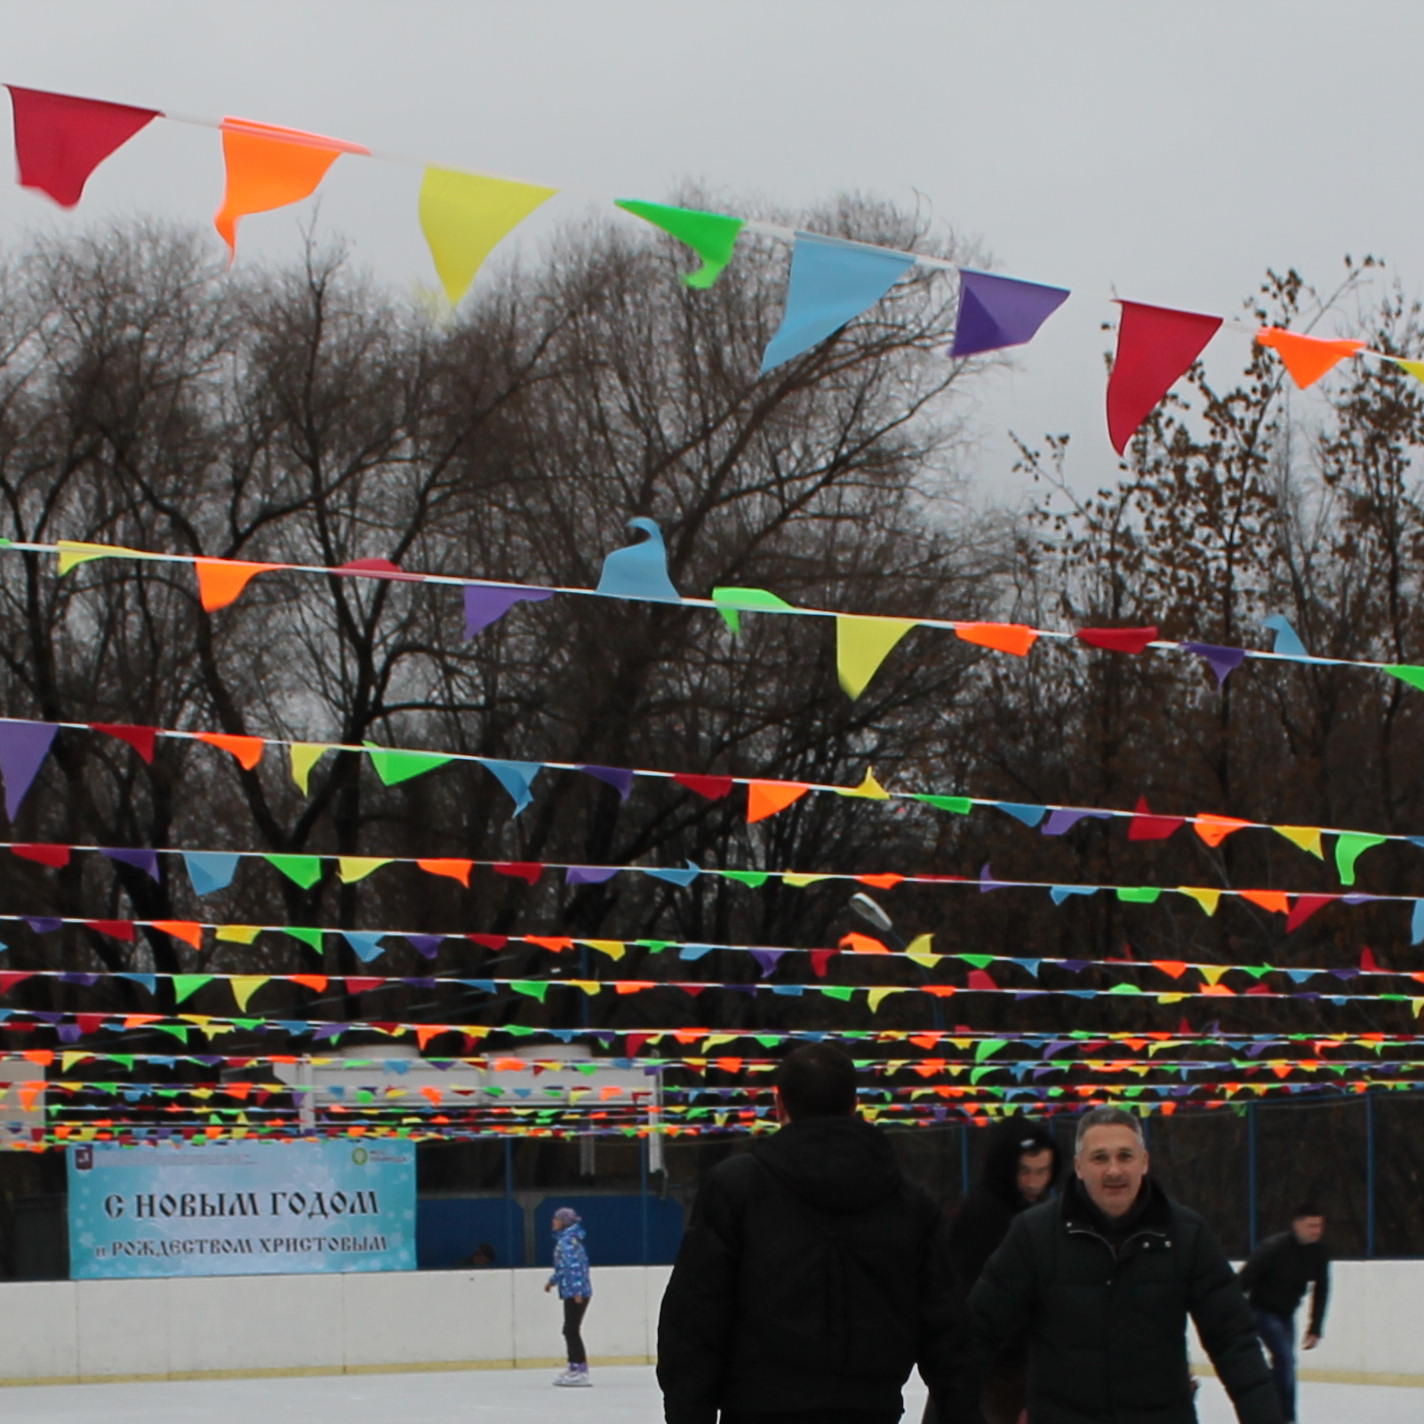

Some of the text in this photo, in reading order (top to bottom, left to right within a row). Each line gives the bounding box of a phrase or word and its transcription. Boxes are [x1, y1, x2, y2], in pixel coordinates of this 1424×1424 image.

[104, 1191, 379, 1219] С НОВЫМ ГОДОМ
[111, 1239, 252, 1257] РОЖДЕСТВОМ
[260, 1236, 388, 1254] ХРИСТОВЫМ
